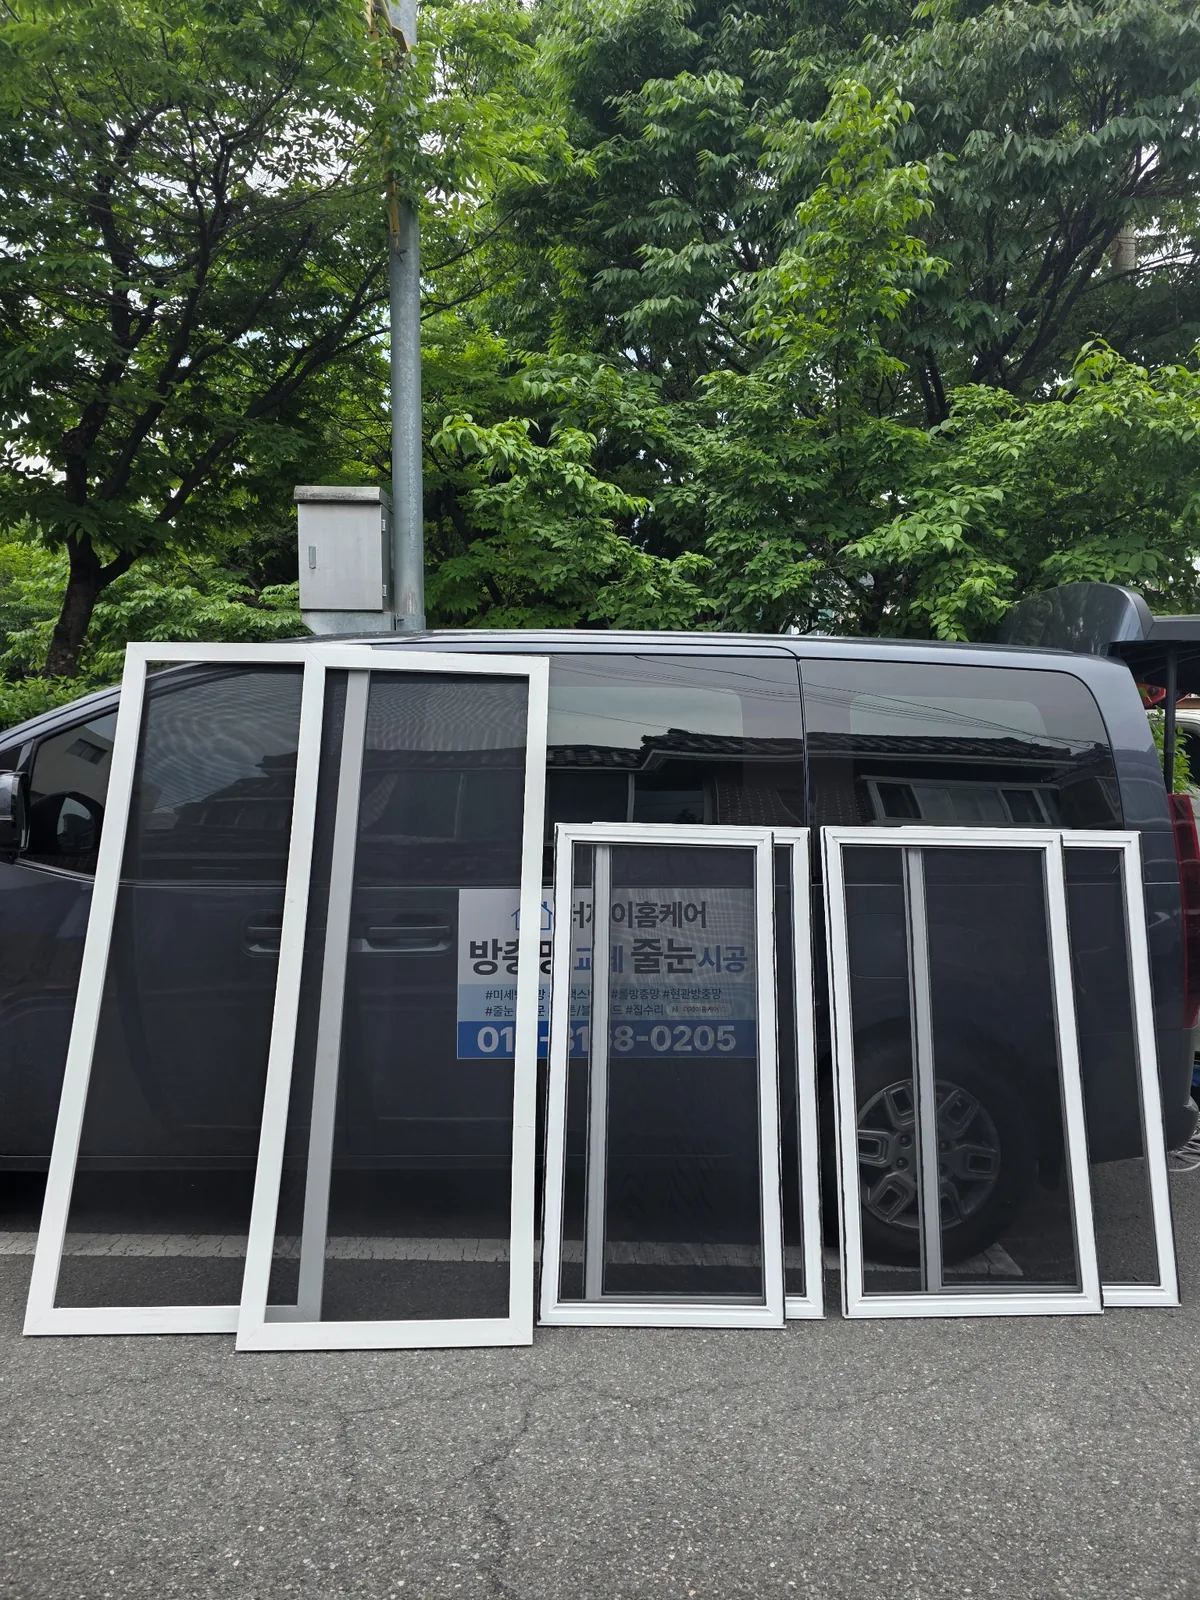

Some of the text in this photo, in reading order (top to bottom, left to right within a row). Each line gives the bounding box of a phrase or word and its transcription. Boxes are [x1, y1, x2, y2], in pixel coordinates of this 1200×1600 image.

[572, 901, 707, 928] 이홈케어
[630, 938, 697, 975] 줄눈
[698, 945, 749, 974] 시공
[485, 988, 546, 1001] #미세망
[662, 987, 722, 1000] #현관방충망
[485, 1005, 515, 1017] #줄눈
[626, 1004, 664, 1016] #집수리
[477, 1025, 737, 1053] 01-18-0205
